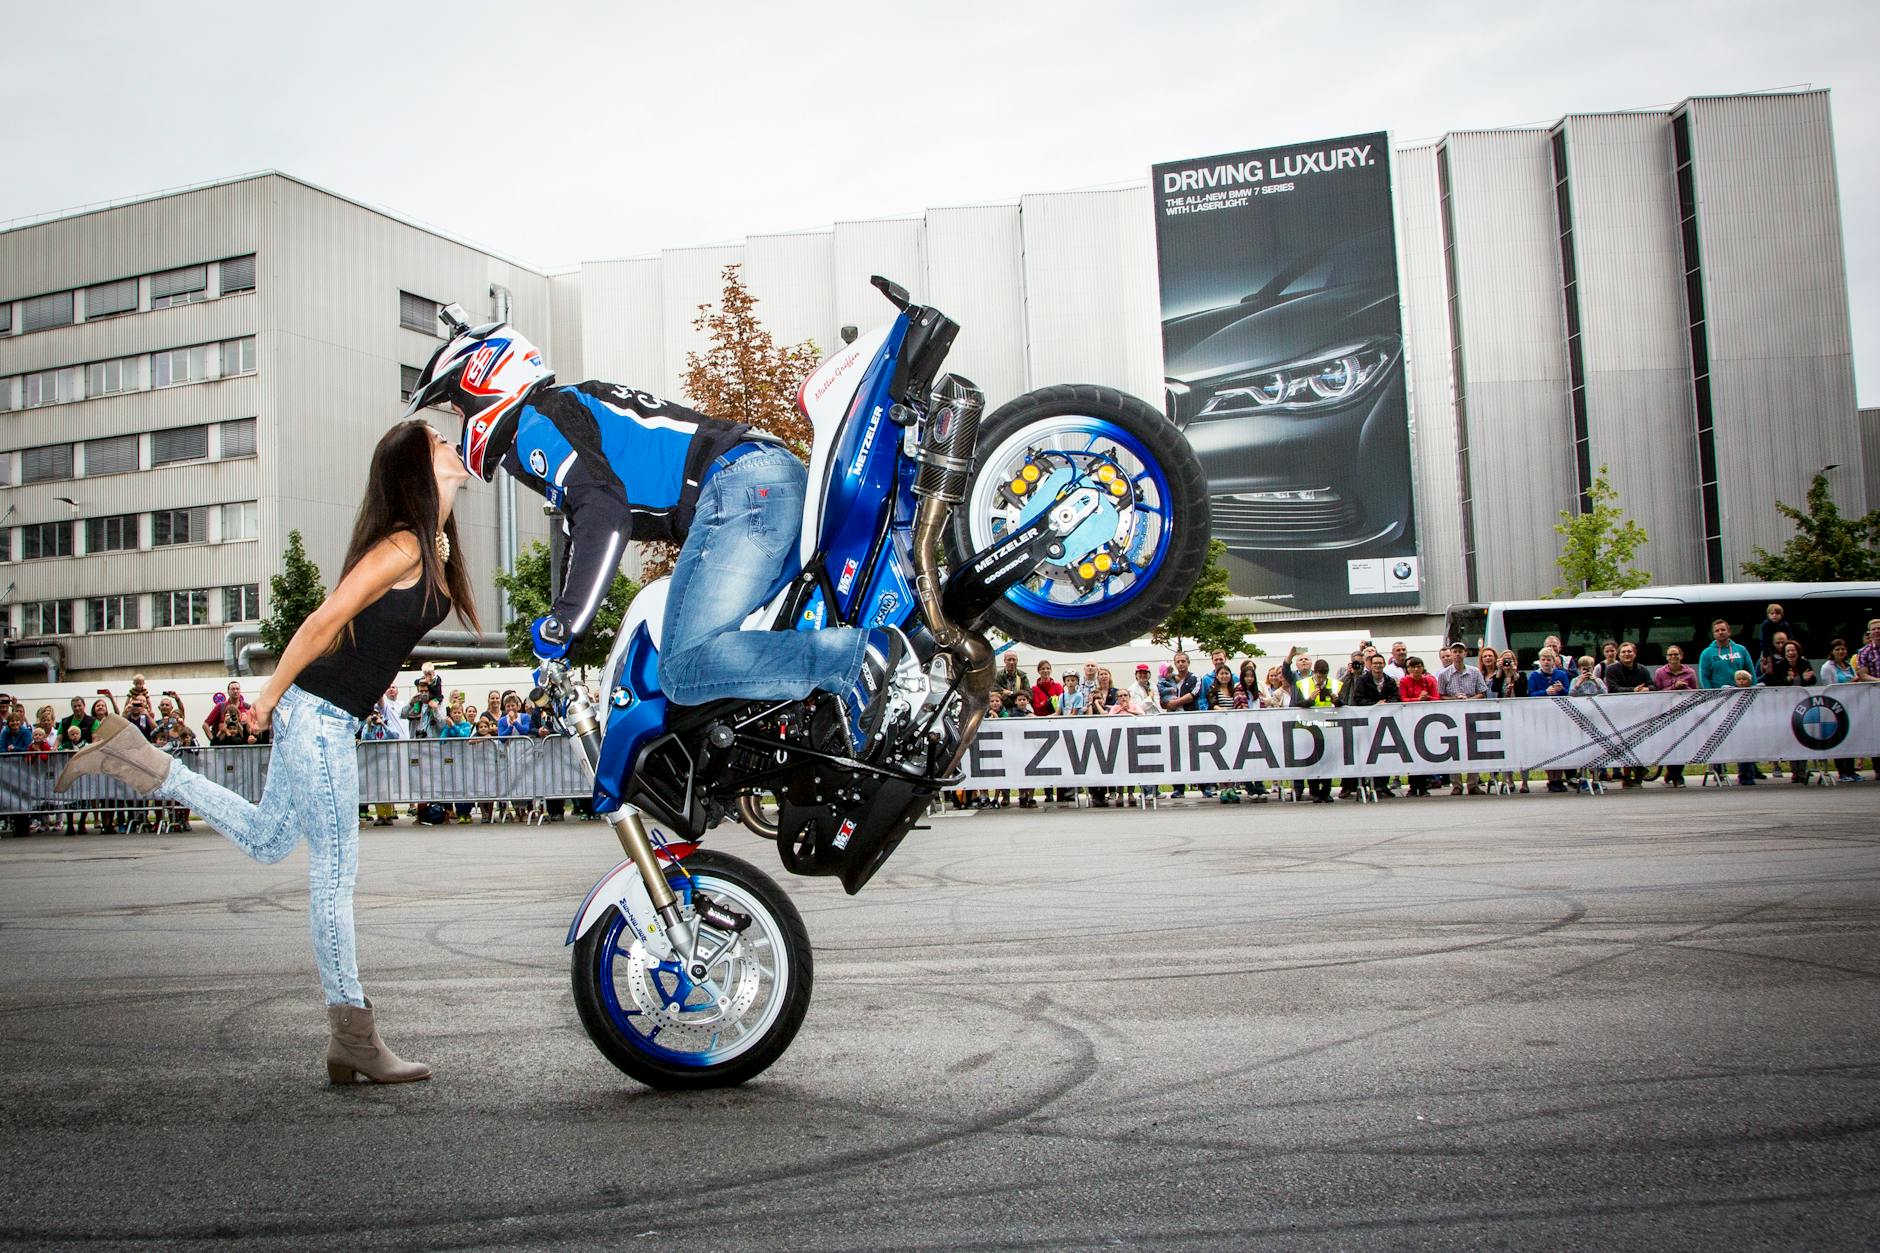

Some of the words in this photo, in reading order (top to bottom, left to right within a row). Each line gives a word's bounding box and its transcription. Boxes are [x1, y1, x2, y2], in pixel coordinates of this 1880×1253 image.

[1164, 160, 1263, 193] DRIVING
[1269, 145, 1375, 179] LUXURY.
[1165, 197, 1184, 207] THE
[1185, 192, 1227, 205] ALL-NEW
[1229, 187, 1252, 199] BMW
[1254, 187, 1260, 196] 7
[1262, 182, 1294, 195] SERIES
[1166, 206, 1190, 216] WITH
[1191, 197, 1249, 213] LASERLIGHT.
[853, 405, 884, 475] METZELER
[974, 528, 1039, 573] METZELER
[1024, 711, 1505, 777] ZWEIRADTAGE
[619, 897, 647, 943] METZELER
